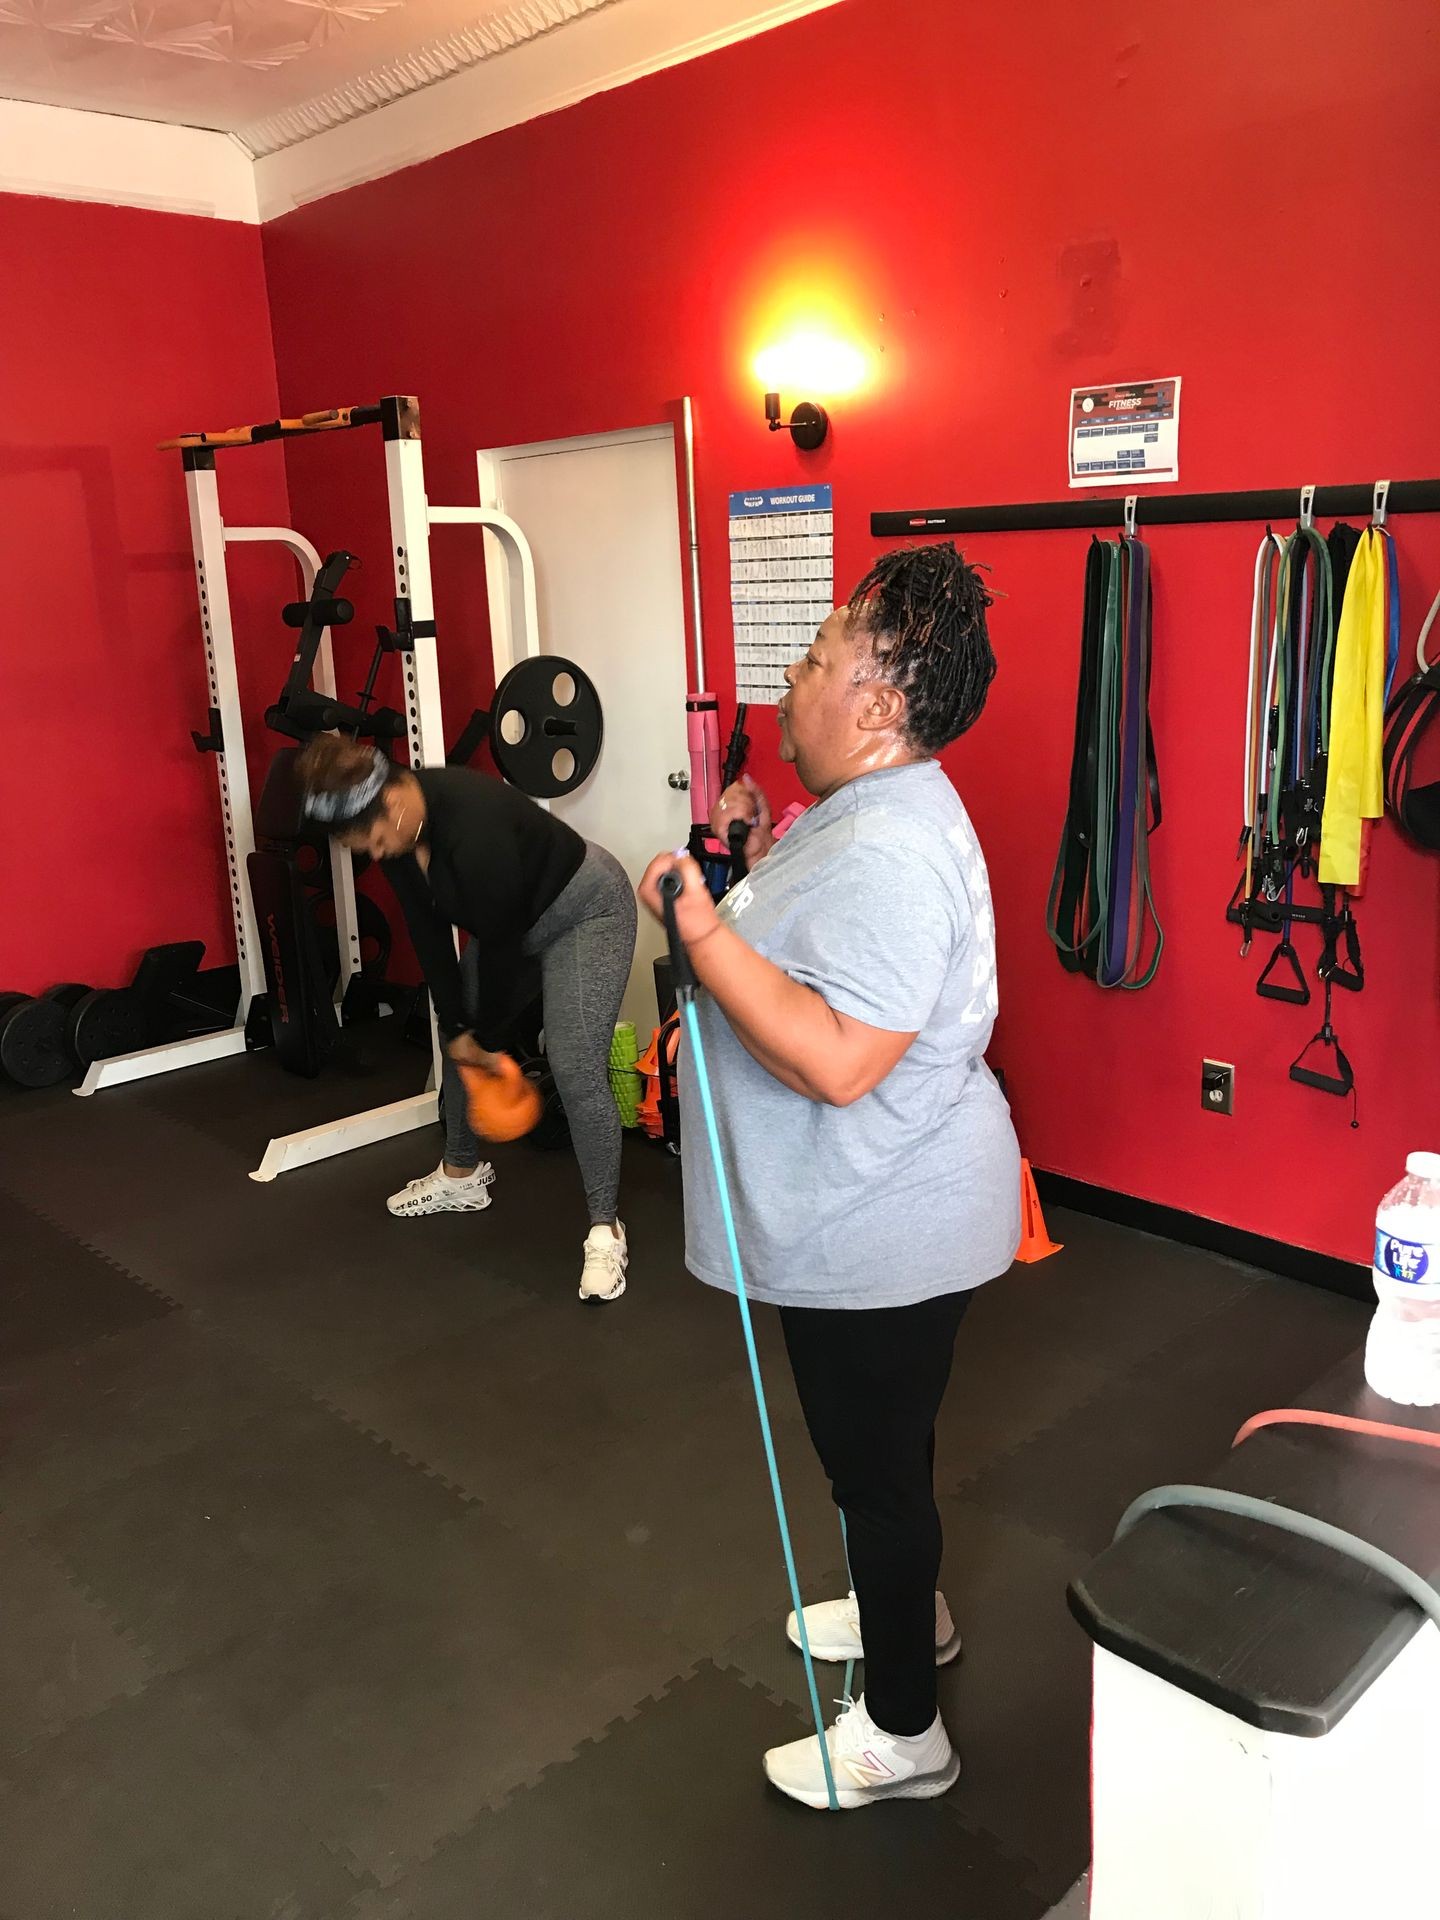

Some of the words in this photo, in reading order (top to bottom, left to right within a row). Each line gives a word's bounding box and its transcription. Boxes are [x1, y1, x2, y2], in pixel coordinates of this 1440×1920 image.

[1108, 398, 1142, 408] FITNESS
[770, 495, 798, 505] WORKOUT
[798, 494, 816, 503] GUIDE
[477, 1173, 496, 1186] JUST
[407, 1199, 419, 1208] SO
[421, 1195, 433, 1204] SO
[1391, 1239, 1424, 1258] Pure
[1393, 1251, 1421, 1270] Life
